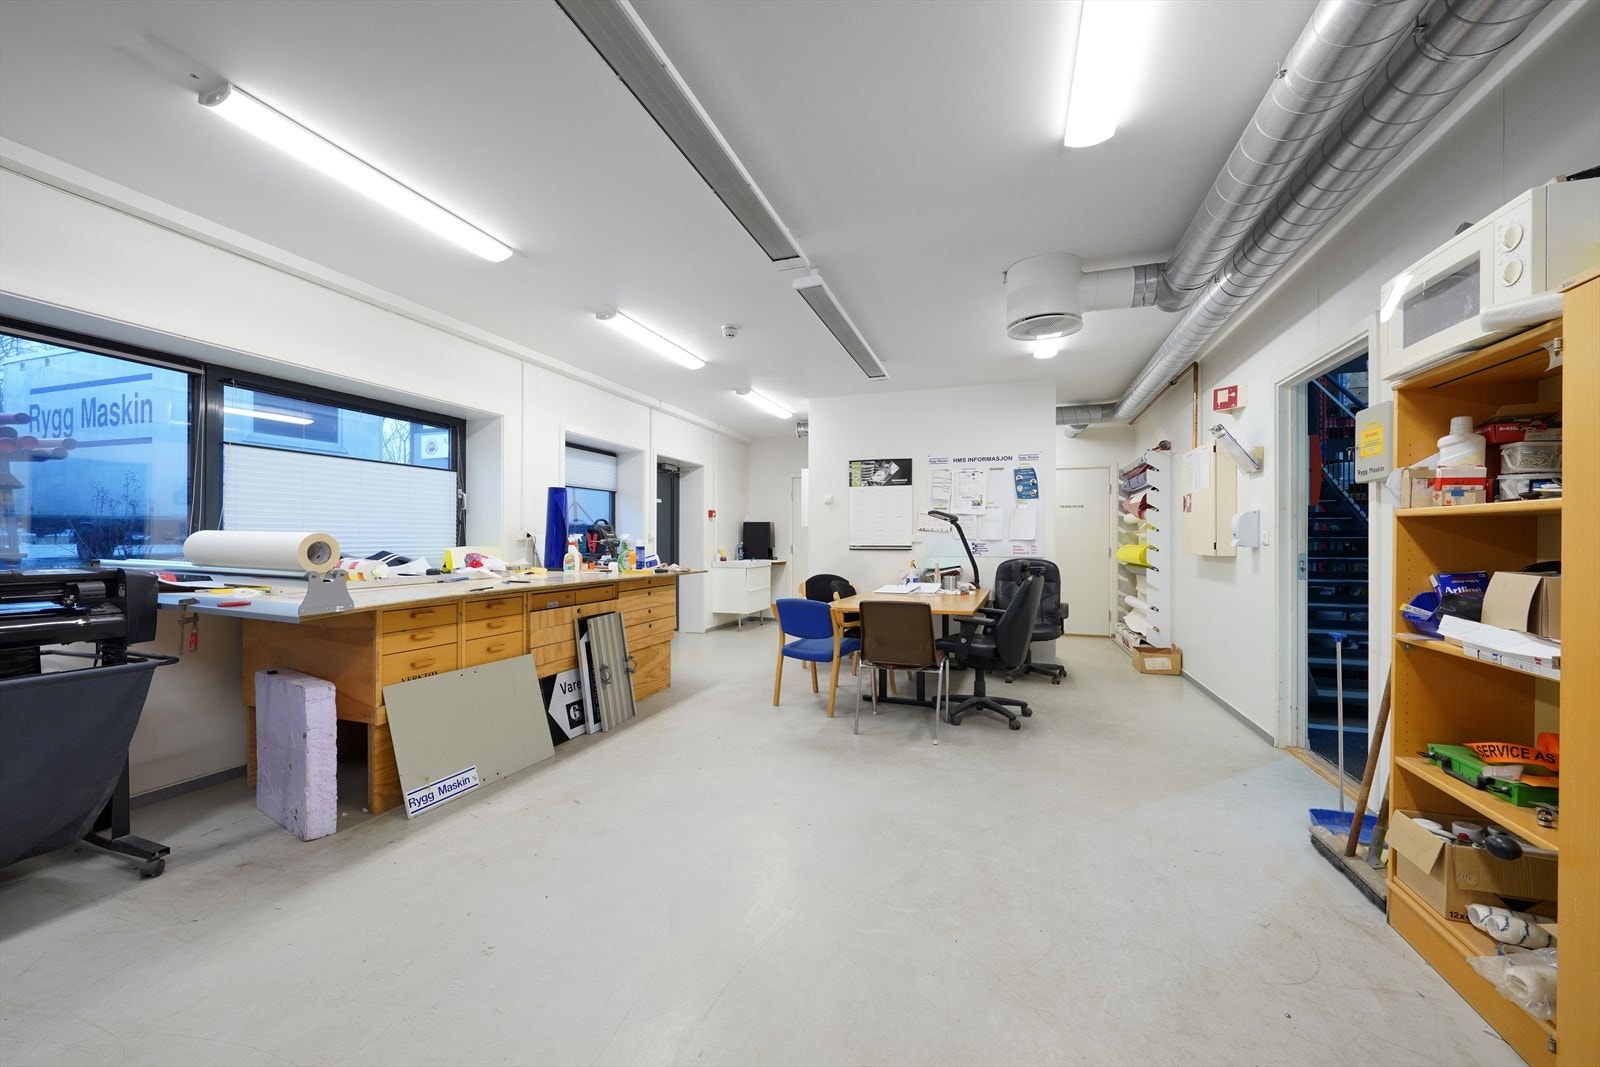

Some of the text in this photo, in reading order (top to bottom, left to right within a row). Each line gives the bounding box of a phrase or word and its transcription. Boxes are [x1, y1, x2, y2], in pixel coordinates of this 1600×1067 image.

[29, 392, 153, 438] Rygg Maskin
[560, 680, 582, 695] Vare
[1476, 744, 1556, 764] SERVICE AS
[408, 777, 471, 808] Rygg Maskin
